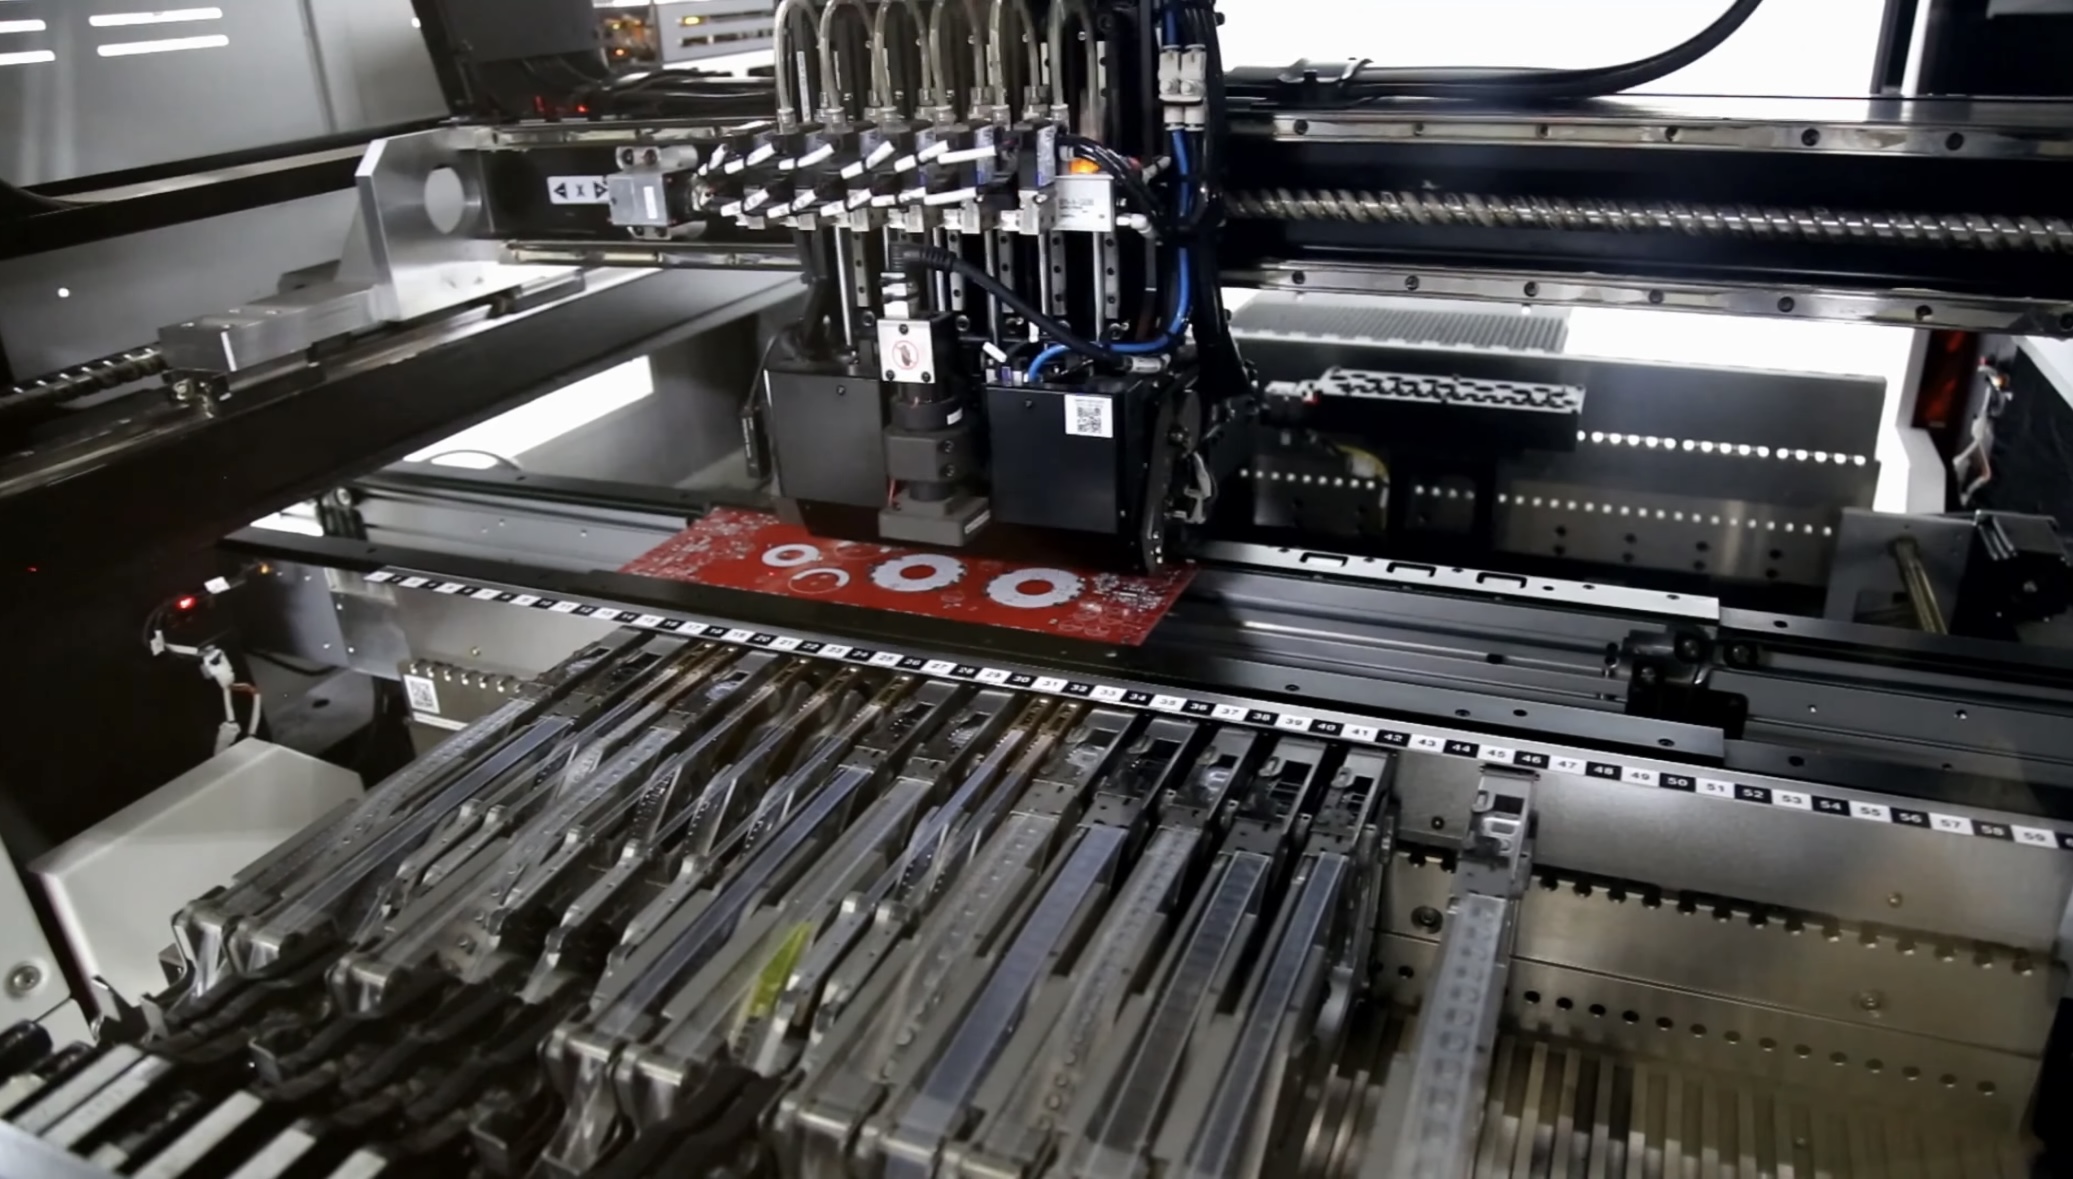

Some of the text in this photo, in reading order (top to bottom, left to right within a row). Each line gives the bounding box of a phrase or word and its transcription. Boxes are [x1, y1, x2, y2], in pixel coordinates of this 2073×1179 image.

[576, 185, 585, 196] X
[904, 658, 921, 666] 26
[1070, 684, 1088, 692] 32
[1129, 693, 1146, 701] 34
[1190, 703, 1208, 711] 36
[1253, 713, 1271, 721] 38
[1285, 718, 1303, 726] 39
[1318, 723, 1336, 731] 40
[1384, 734, 1403, 742] 42
[1418, 739, 1436, 747] 43
[1452, 744, 1470, 752] 44
[1488, 750, 1505, 758] 45
[1522, 755, 1541, 763] 46
[1594, 766, 1614, 775] 48
[1631, 772, 1650, 780] 49
[1668, 777, 1688, 786] 50
[1707, 783, 1725, 792] 51
[1743, 789, 1764, 798] 52
[1782, 795, 1802, 804] 53
[1820, 800, 1841, 810] 54
[1860, 807, 1881, 817] 55
[1899, 813, 1922, 823] 56
[1940, 819, 1961, 828] 57
[1981, 825, 2004, 836] 58
[2024, 832, 2046, 842] 59
